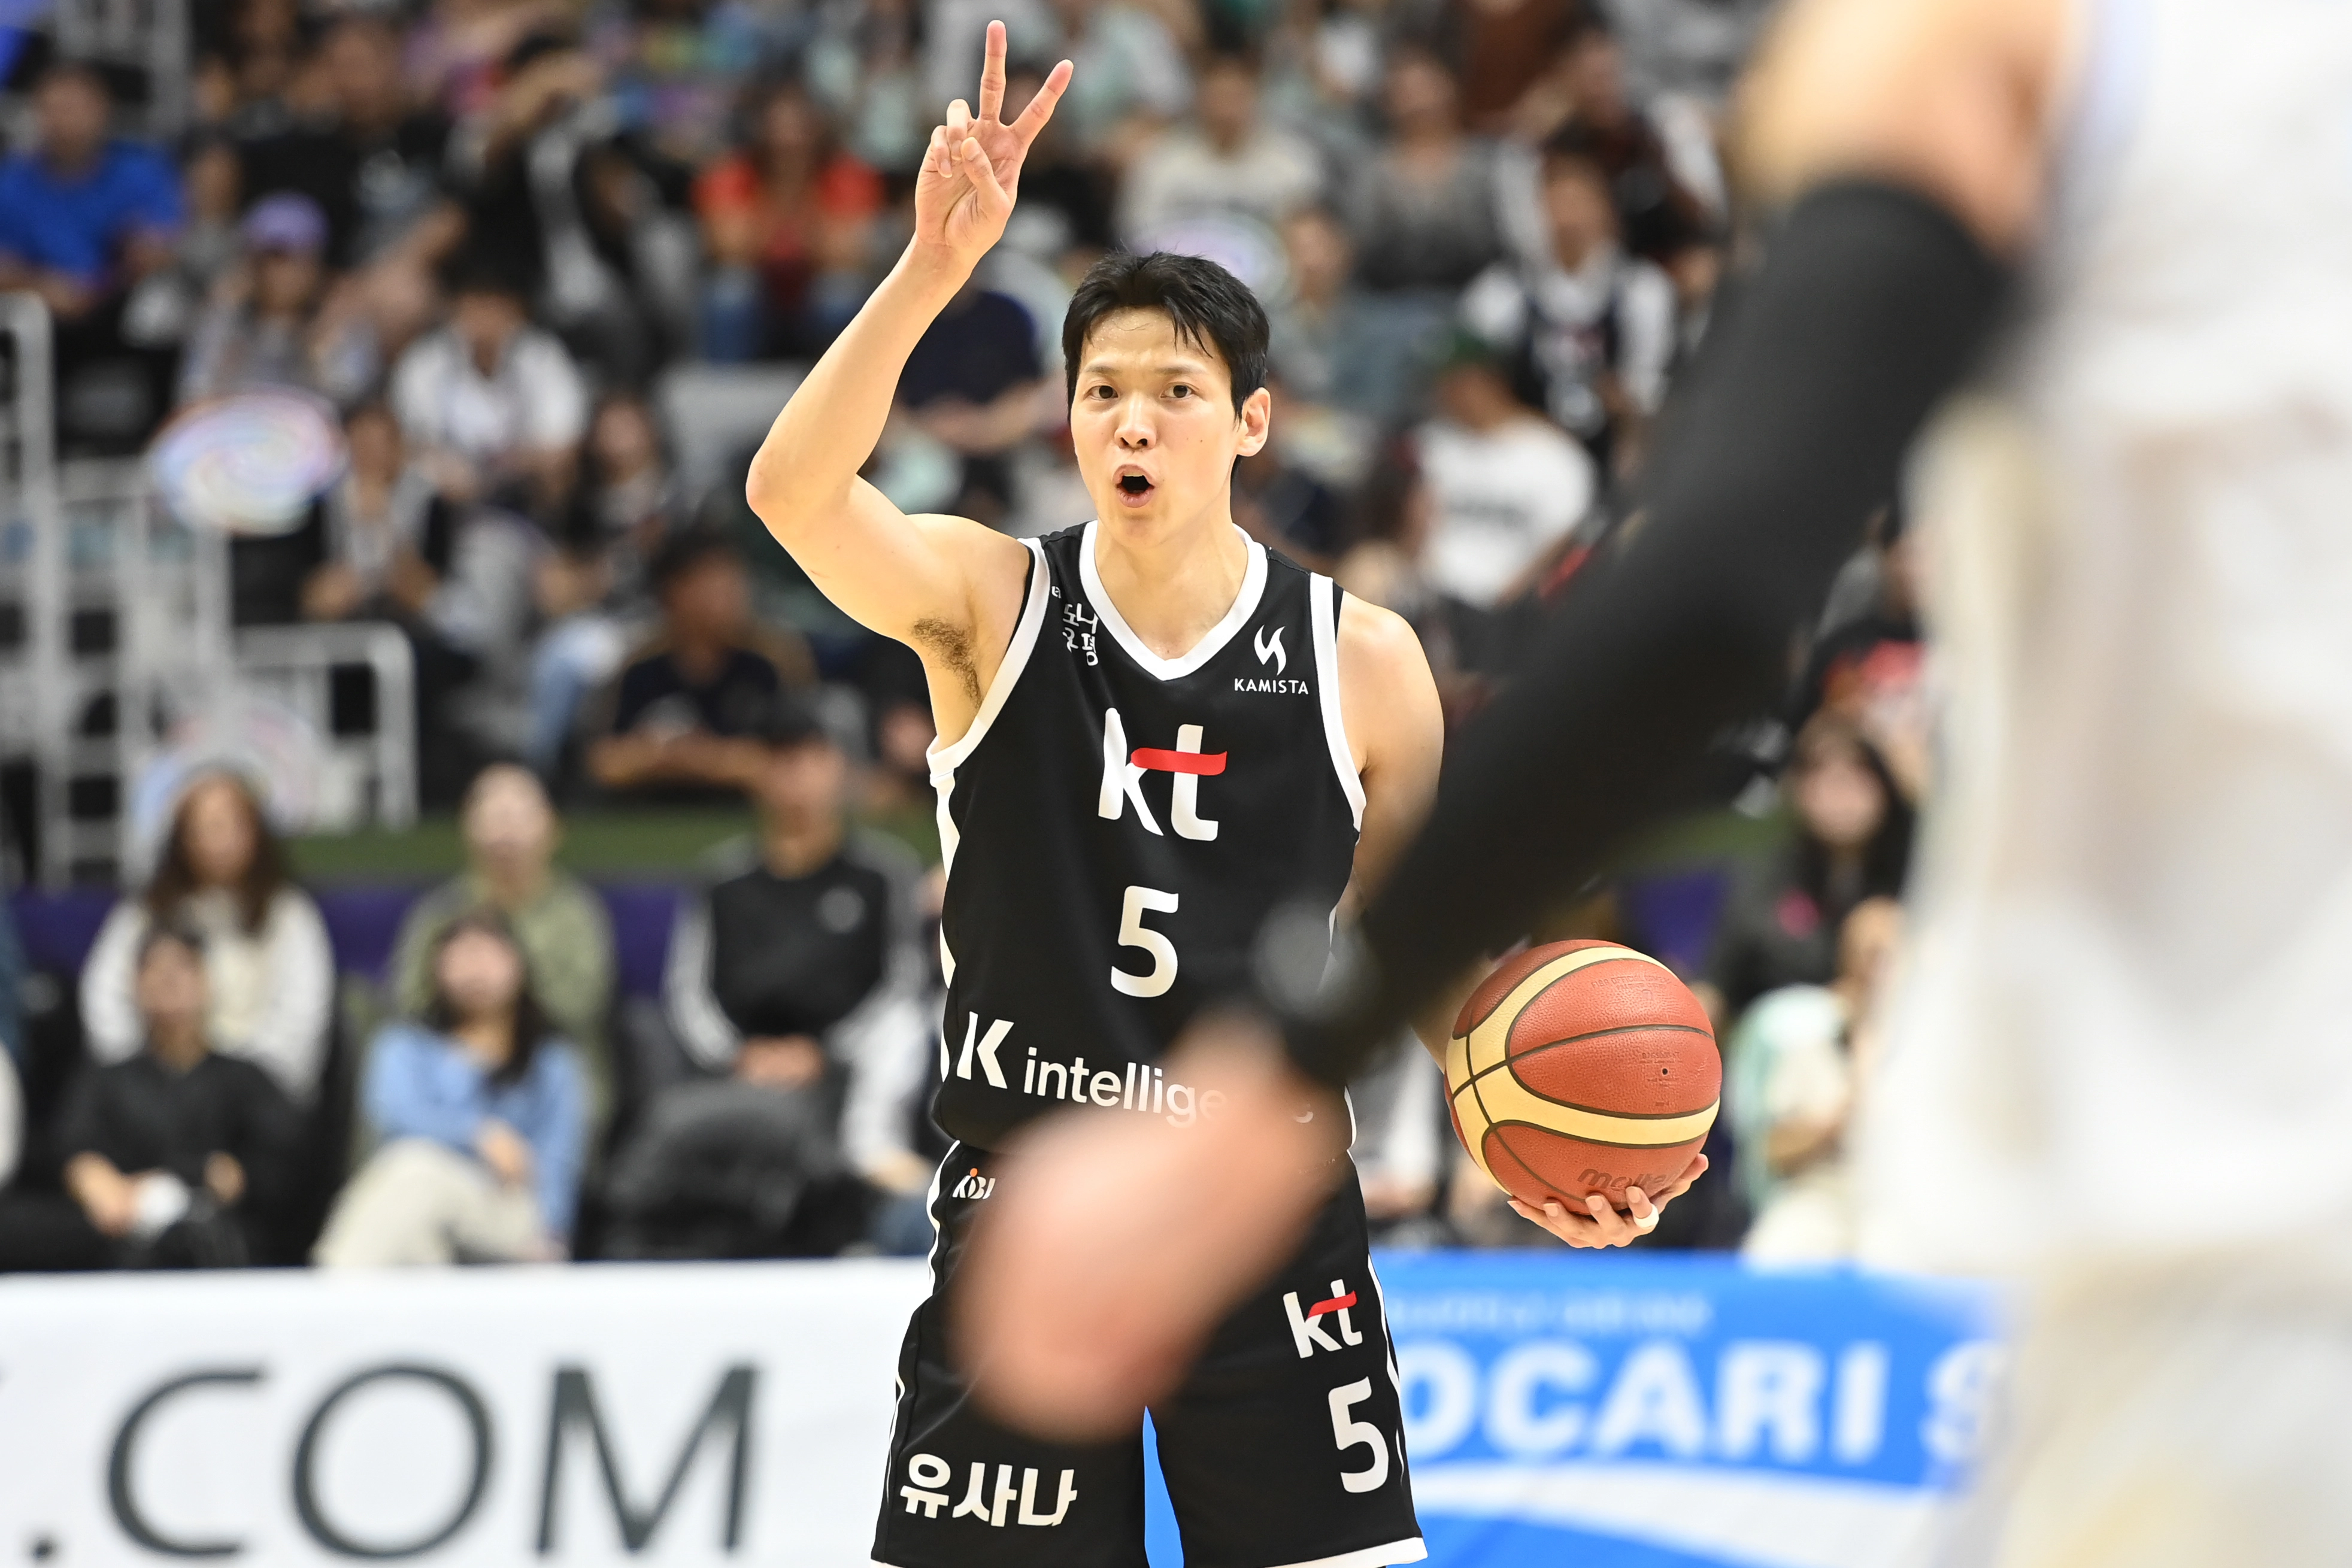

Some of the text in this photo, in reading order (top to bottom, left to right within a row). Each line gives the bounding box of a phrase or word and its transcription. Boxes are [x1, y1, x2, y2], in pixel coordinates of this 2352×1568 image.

[1234, 678, 1310, 695] KAMISTA
[1098, 707, 1228, 842] kt
[1110, 885, 1179, 998] 5
[956, 1011, 1314, 1129] K intellige
[1577, 1168, 1675, 1191] molte
[1283, 1279, 1363, 1359] kt
[1327, 1376, 1390, 1493] 5
[1396, 1336, 1892, 1466] OCARI
[0, 1359, 765, 1565] .COM
[899, 1453, 1078, 1527] 유사나
